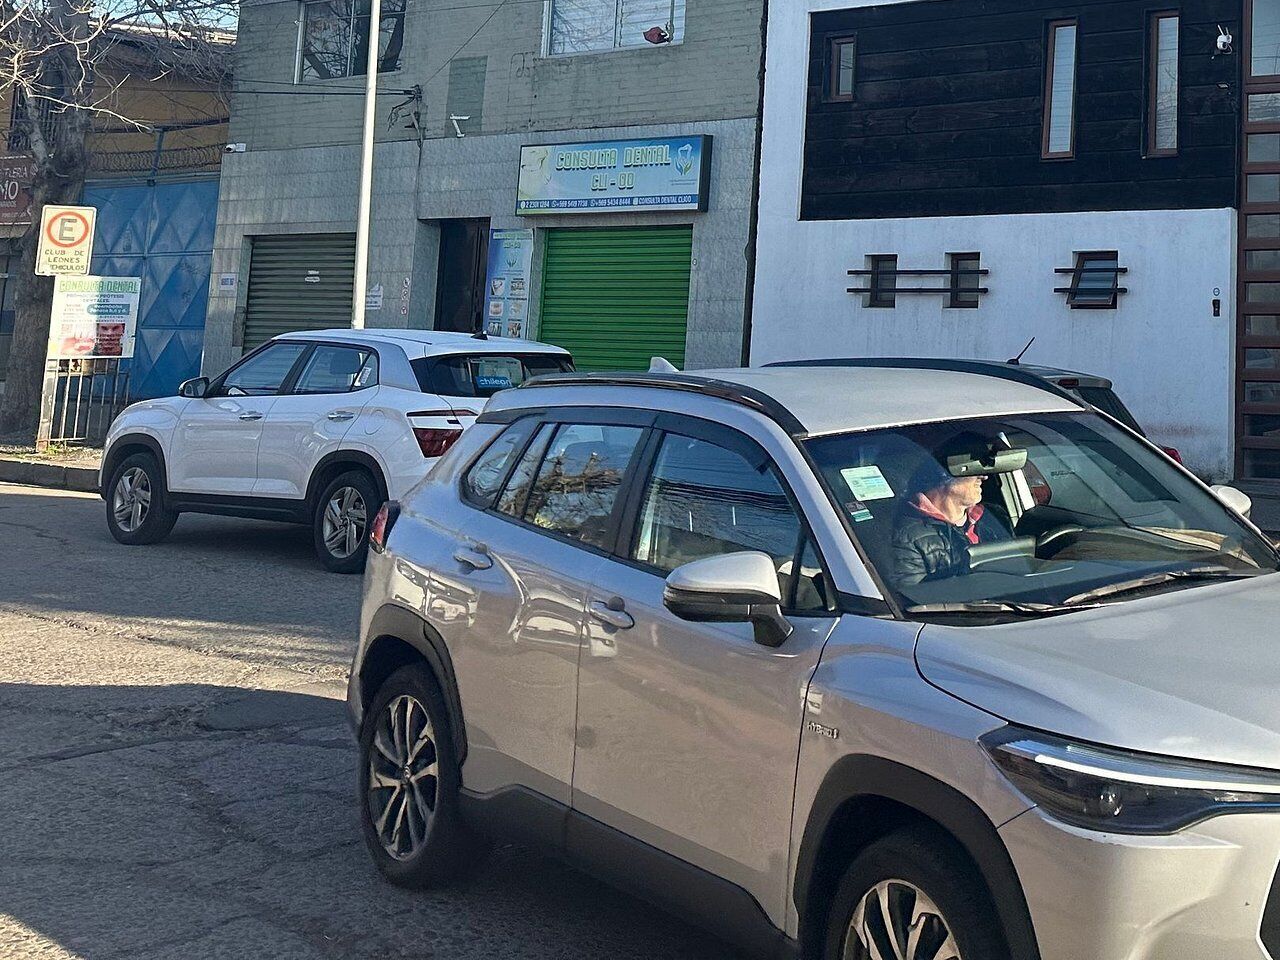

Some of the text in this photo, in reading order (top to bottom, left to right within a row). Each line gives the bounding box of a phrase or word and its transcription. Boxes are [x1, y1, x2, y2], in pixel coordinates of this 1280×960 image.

[556, 145, 671, 170] CONSULTA DENTAL
[591, 173, 608, 191] CLI
[59, 218, 77, 241] E
[60, 280, 137, 294] CONSULTA DENTAL
